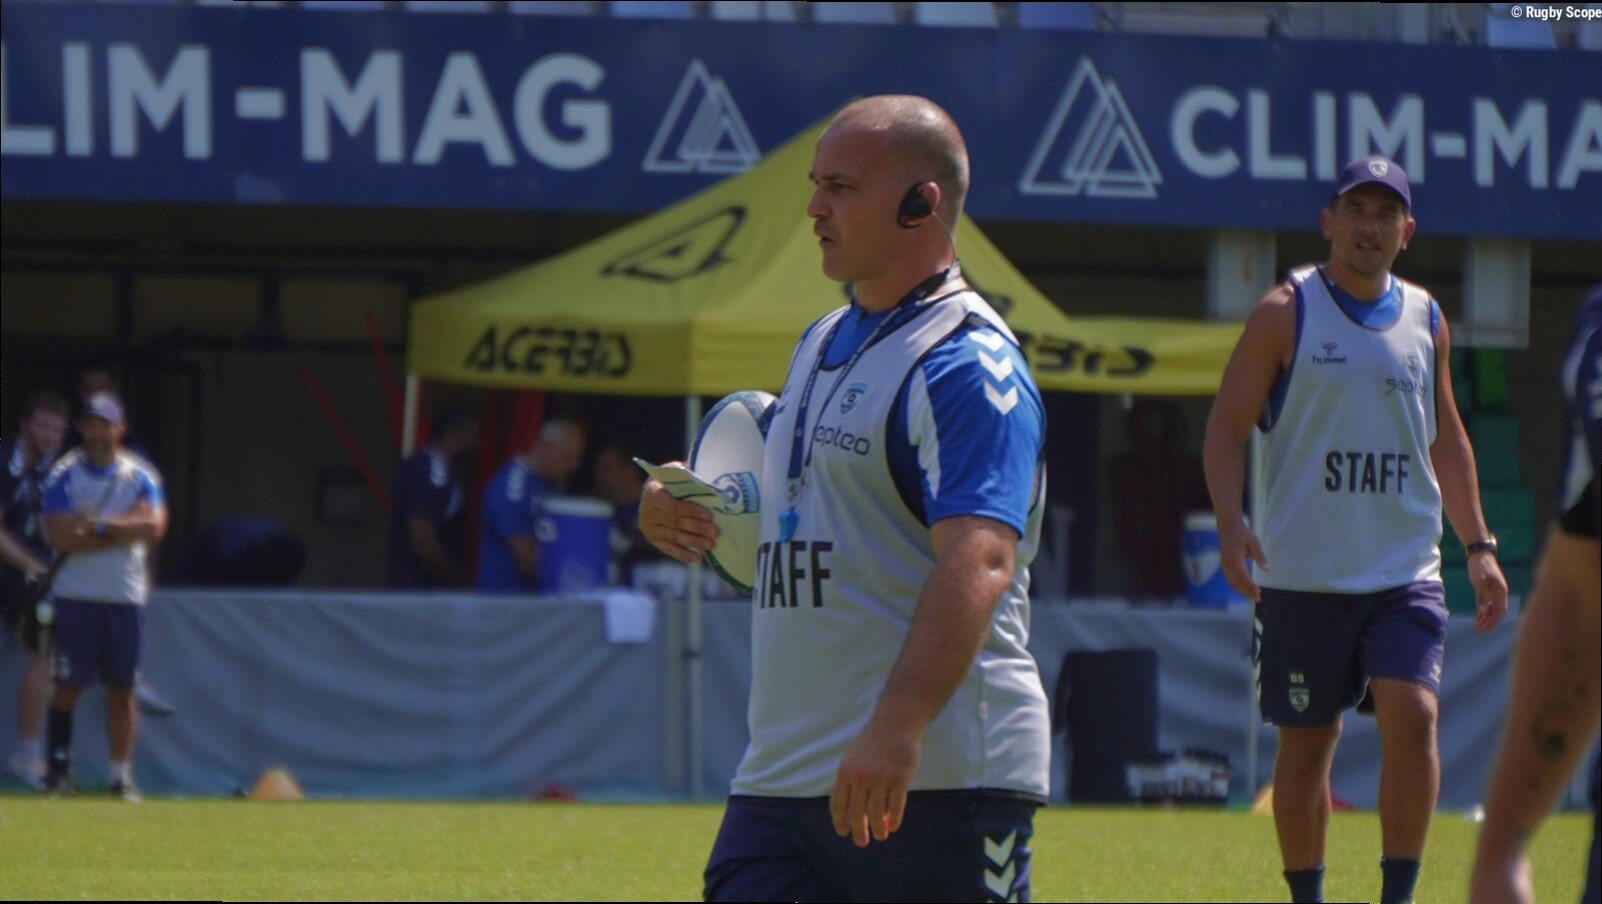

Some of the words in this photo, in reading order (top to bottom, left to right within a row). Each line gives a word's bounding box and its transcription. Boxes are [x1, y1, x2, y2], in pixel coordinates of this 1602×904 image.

[813, 424, 871, 456] epteo
[1325, 450, 1410, 495] STAFF
[757, 541, 834, 609] TAFF
